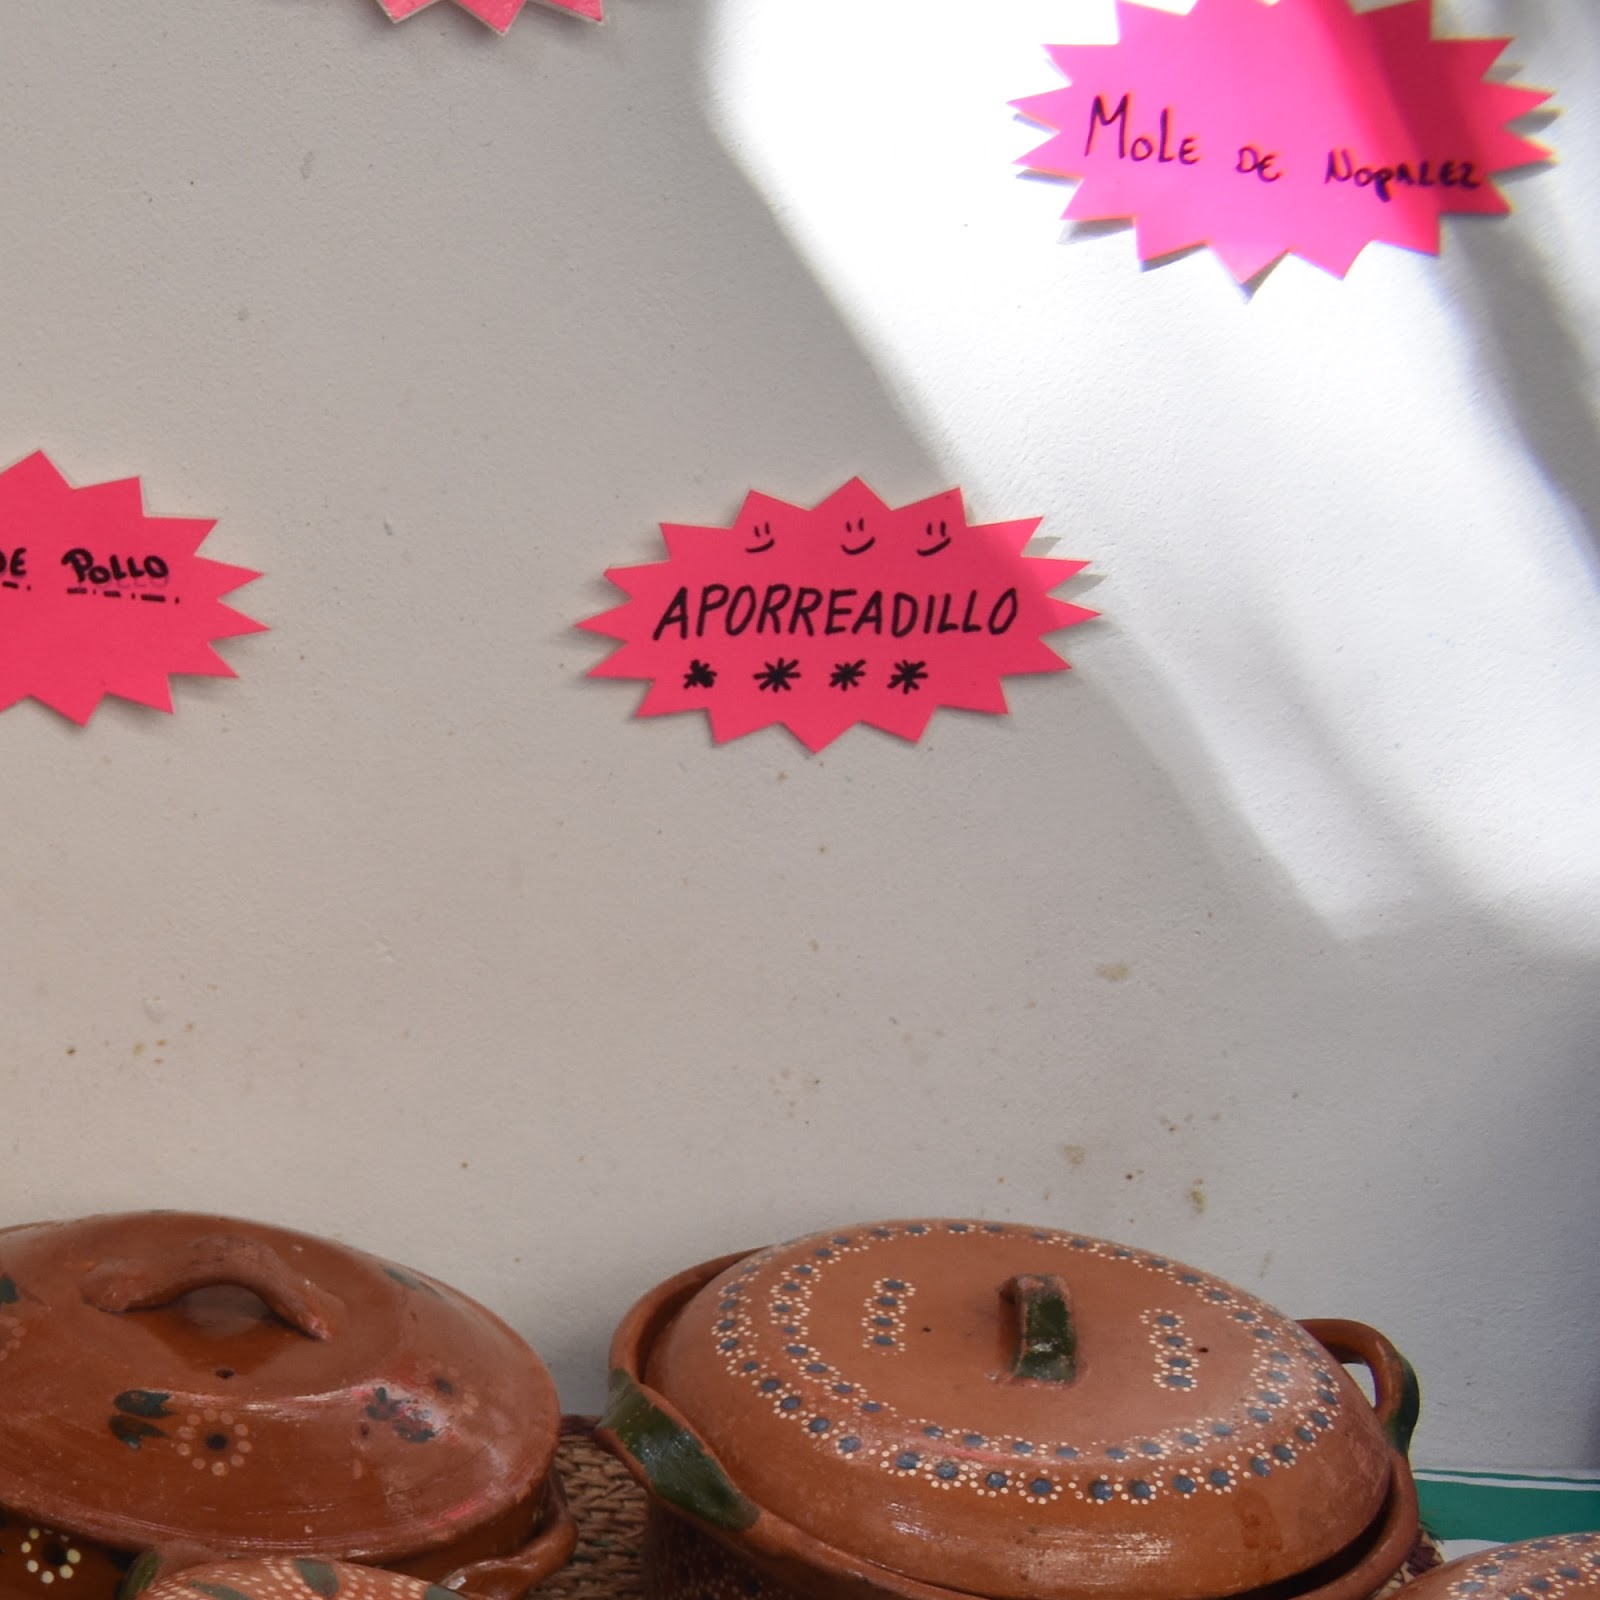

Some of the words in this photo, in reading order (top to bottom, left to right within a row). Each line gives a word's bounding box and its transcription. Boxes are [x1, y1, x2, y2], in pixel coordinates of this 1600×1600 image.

[1084, 94, 1201, 164] MOLE
[1236, 145, 1286, 183] DE
[61, 547, 170, 586] POLLO
[652, 582, 1021, 642] APORREADILLO
